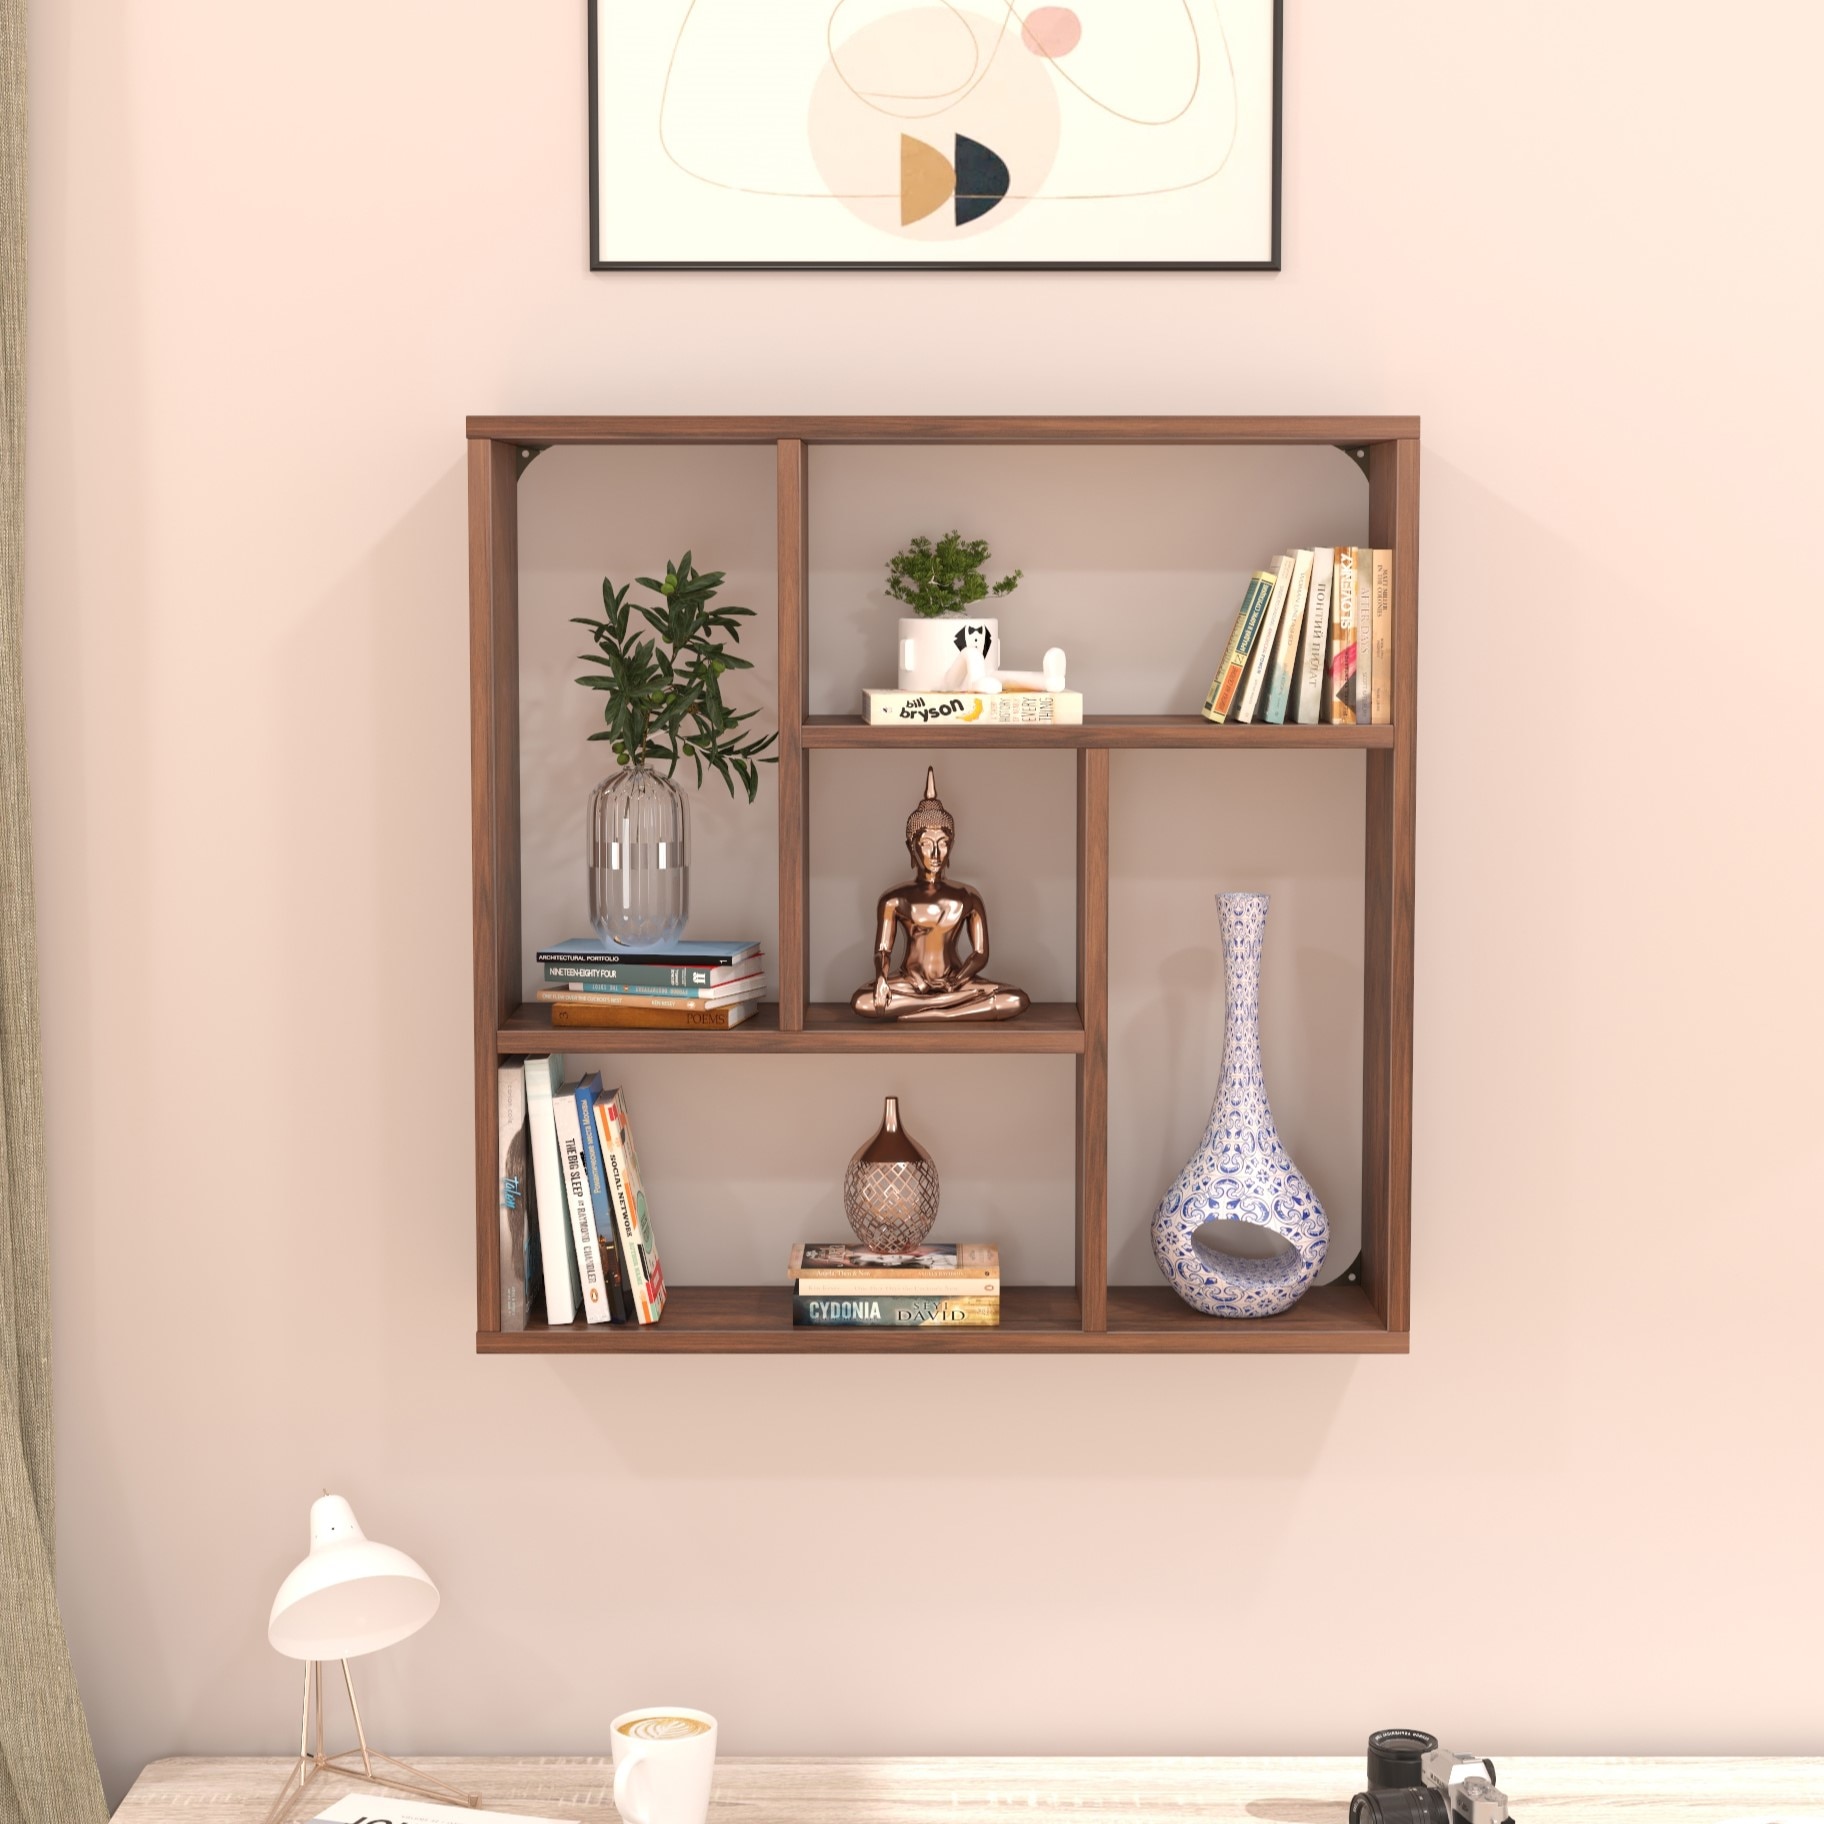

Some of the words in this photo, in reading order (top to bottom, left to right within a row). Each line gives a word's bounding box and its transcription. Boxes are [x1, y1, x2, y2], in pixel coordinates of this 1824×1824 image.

[1313, 583, 1327, 638] ПОНТИЙ
[1361, 588, 1370, 621] AFTER
[1361, 625, 1370, 654] DAYS
[1309, 642, 1321, 688] ПИЛАТ
[900, 699, 964, 722] bryson
[906, 697, 925, 708] bill
[1021, 696, 1037, 722] EVERY
[1039, 697, 1053, 721] THING
[549, 967, 600, 978] NINETEEN-EIGHTY
[601, 969, 617, 978] FOUR
[687, 1013, 725, 1024] POEMS
[565, 1138, 576, 1155] THE
[567, 1155, 578, 1169] BIG
[610, 1154, 621, 1190] SOCIAL
[570, 1171, 583, 1197] SLEEP
[578, 1207, 590, 1242] RAYMOND
[584, 1246, 596, 1283] CHANDLER
[809, 1301, 881, 1319] CYDONIA
[898, 1310, 965, 1321] DAVID
[914, 1302, 948, 1310] SEYI
